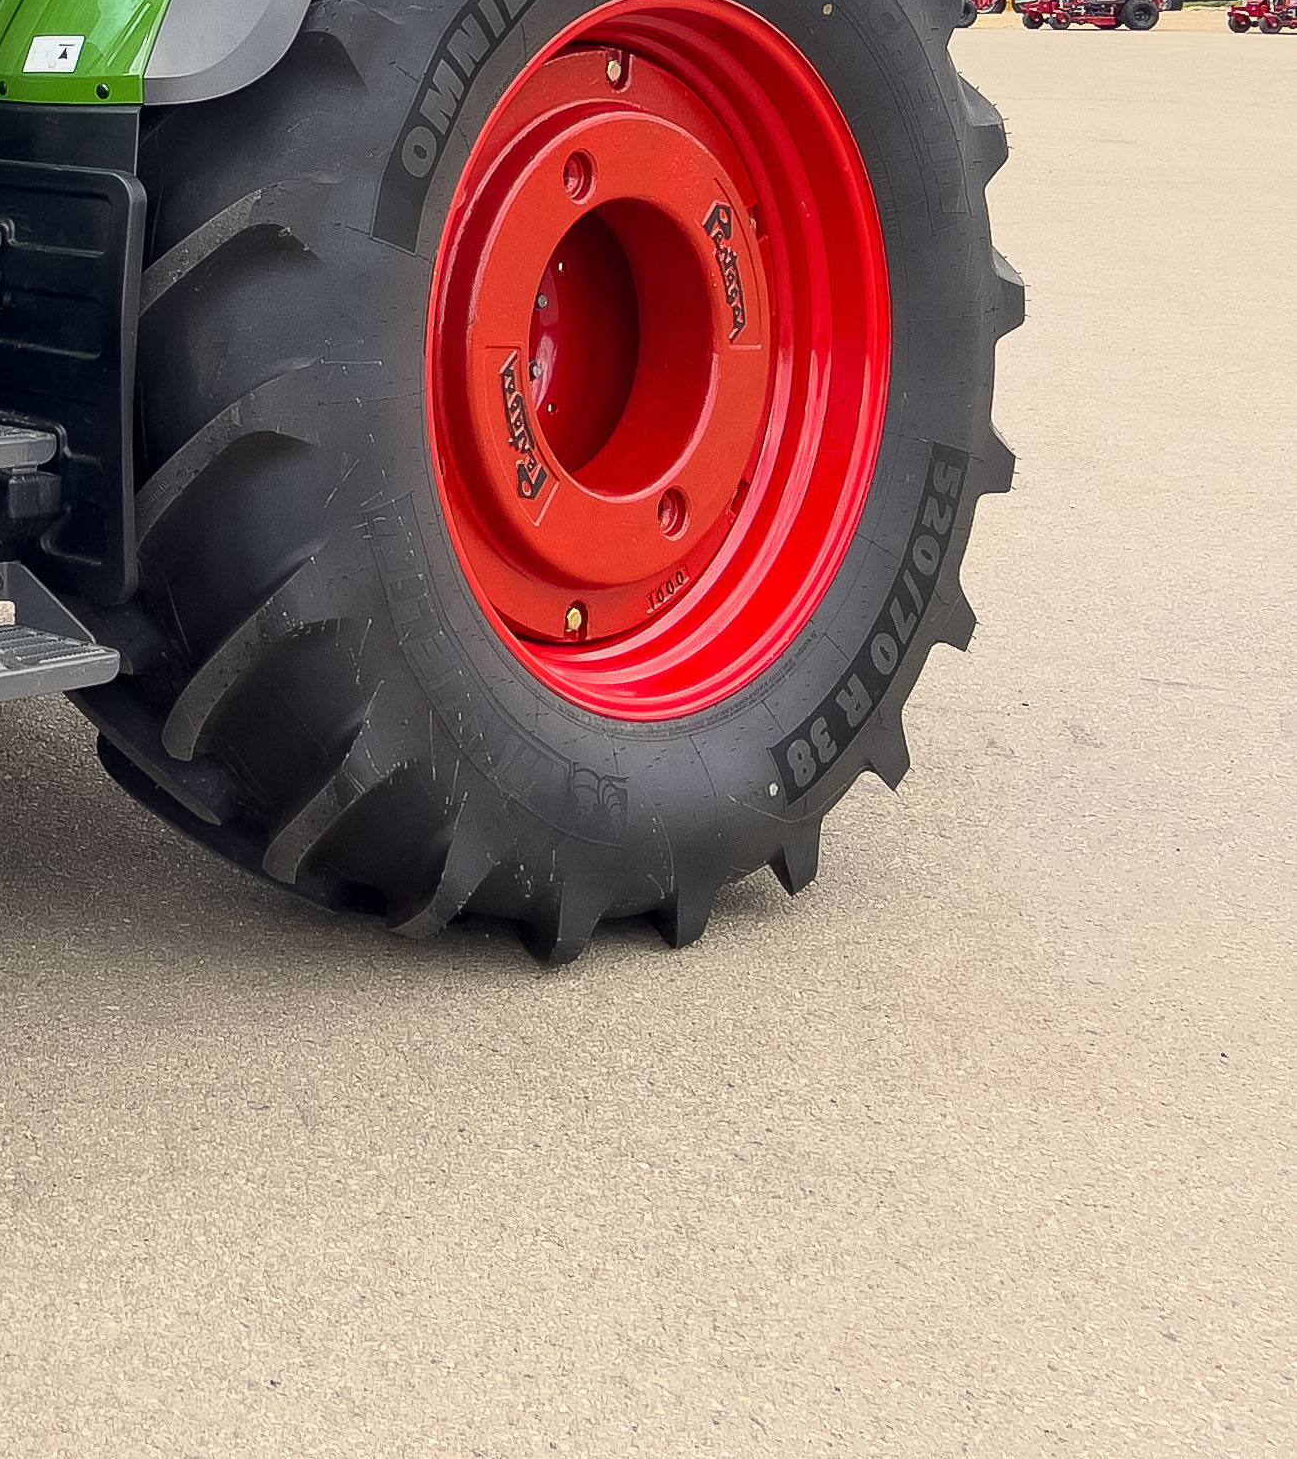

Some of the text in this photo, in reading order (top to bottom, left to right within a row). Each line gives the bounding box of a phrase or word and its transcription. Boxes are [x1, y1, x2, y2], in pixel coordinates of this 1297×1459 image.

[786, 462, 963, 788] 520/70 R 38
